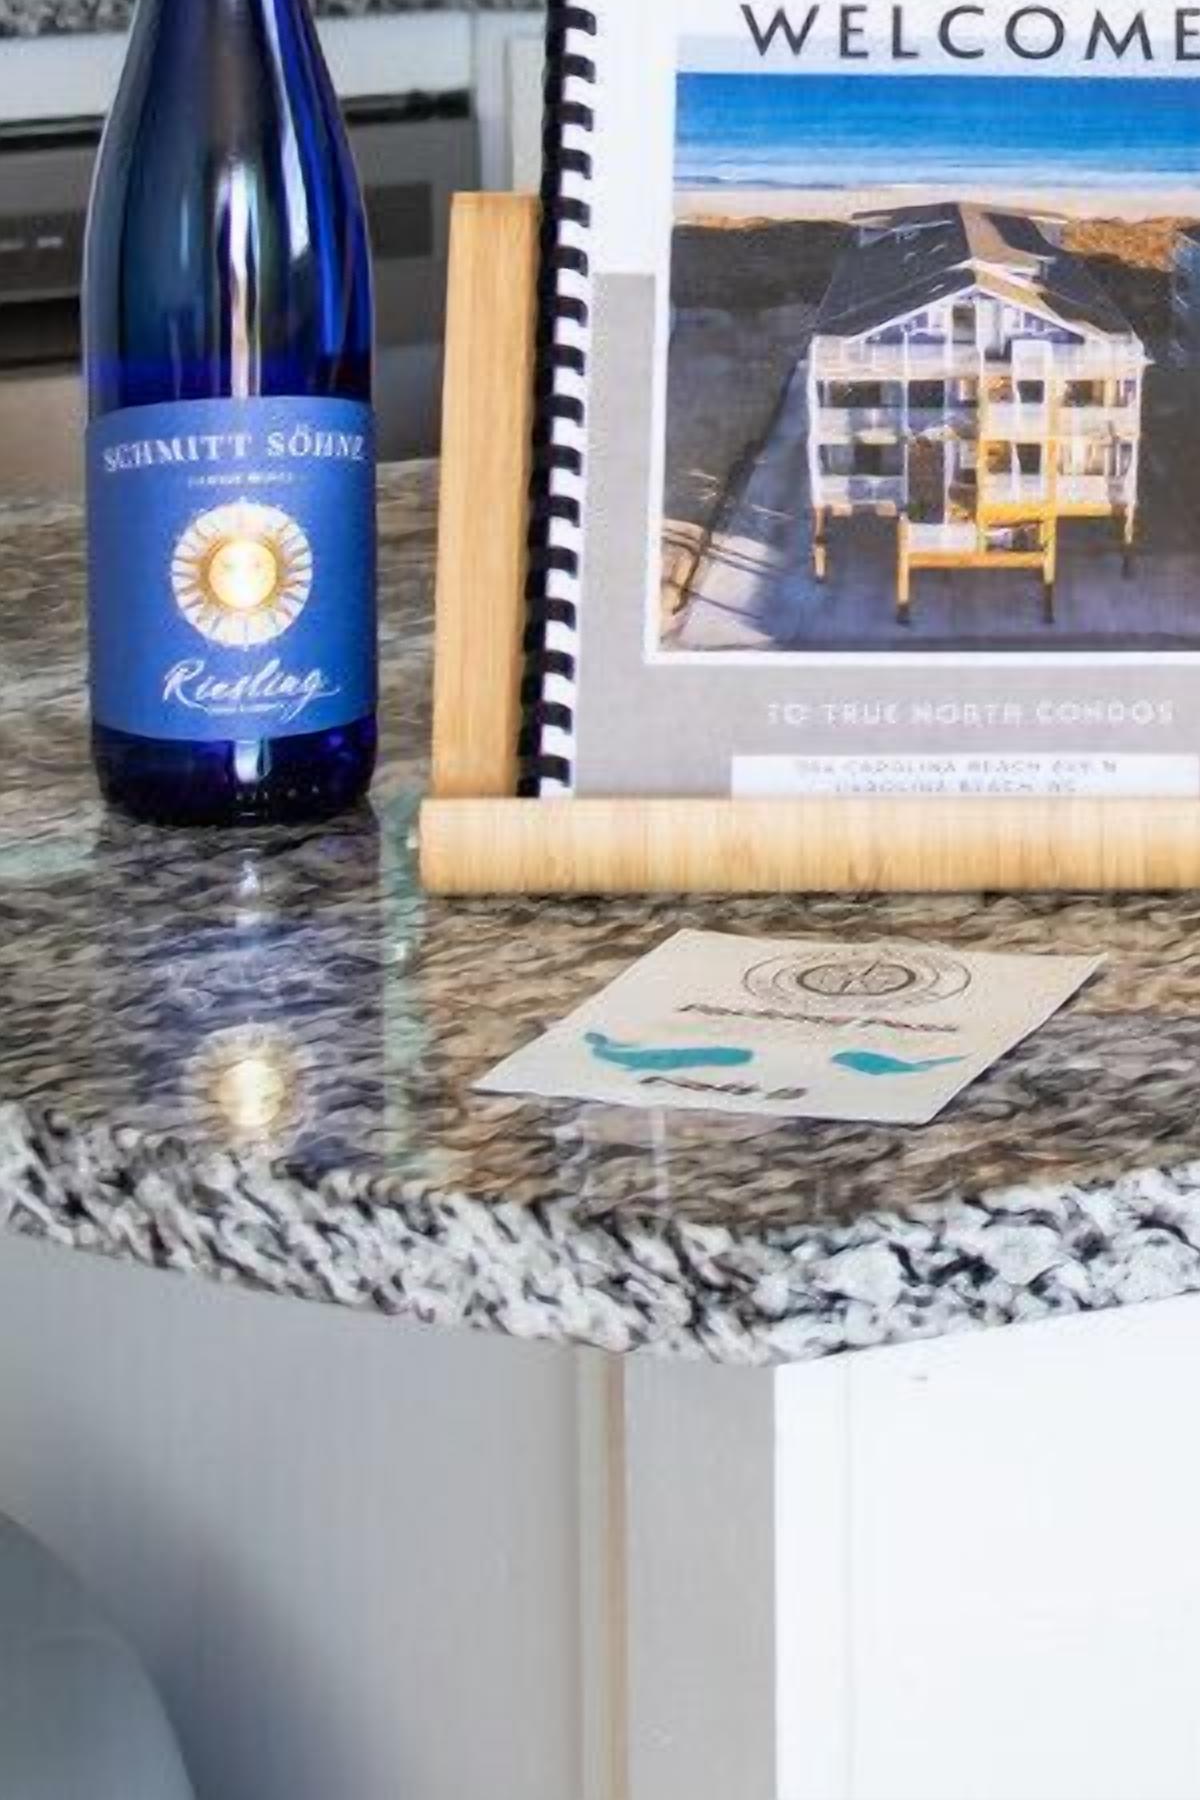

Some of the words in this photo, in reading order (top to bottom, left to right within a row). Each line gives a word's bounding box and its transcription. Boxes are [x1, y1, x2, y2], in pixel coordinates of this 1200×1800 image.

[104, 434, 253, 473] SCHMITT
[162, 657, 341, 723] Riesling
[767, 703, 806, 725] TO
[824, 702, 898, 725] TRUE
[909, 702, 1025, 726] NORTH
[1035, 701, 1174, 725] CONDOS
